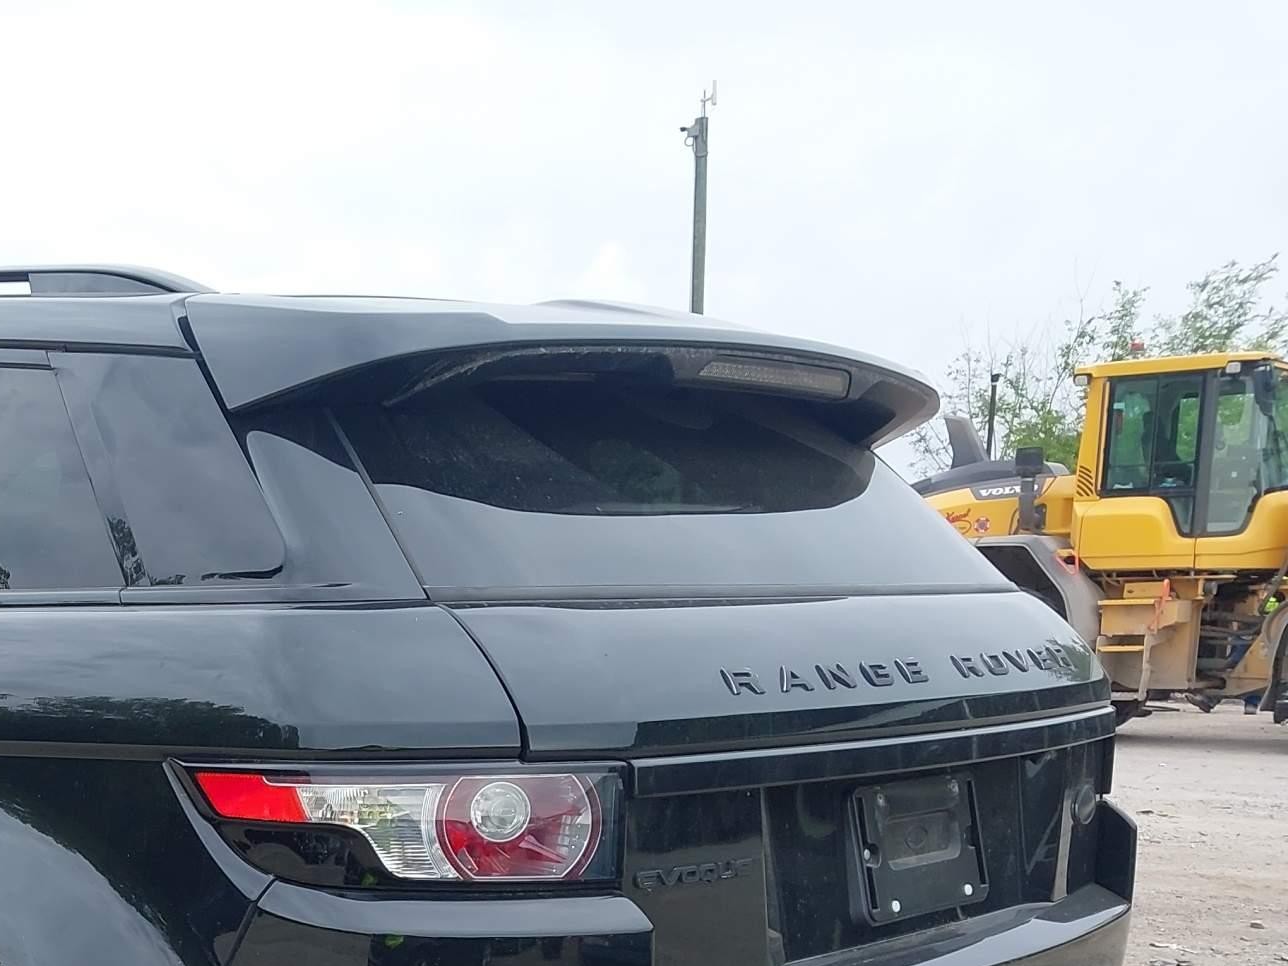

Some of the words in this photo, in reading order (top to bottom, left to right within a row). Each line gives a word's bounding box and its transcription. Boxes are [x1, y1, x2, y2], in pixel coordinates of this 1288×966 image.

[720, 655, 928, 695] RANGE
[950, 643, 1076, 678] ROVER
[635, 857, 753, 889] EVOQUE
